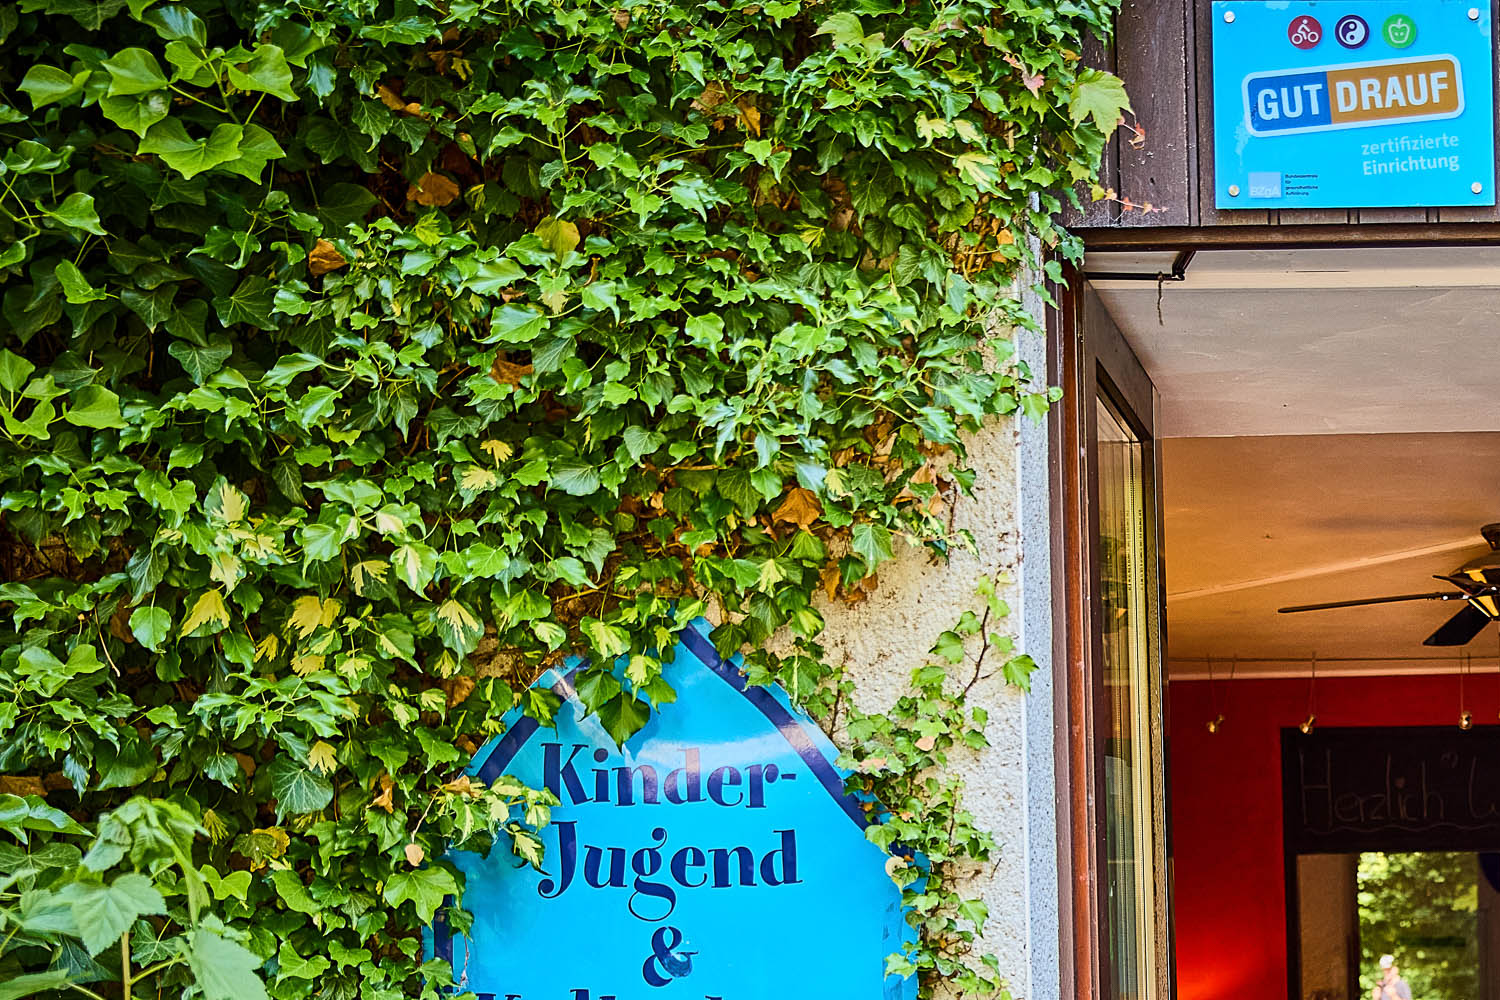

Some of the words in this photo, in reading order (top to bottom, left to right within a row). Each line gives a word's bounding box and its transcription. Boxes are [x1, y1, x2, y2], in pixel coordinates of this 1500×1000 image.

[1257, 83, 1323, 121] GUT
[1335, 71, 1449, 113] DRAUF
[1361, 133, 1460, 156] zertifizierte
[1363, 154, 1460, 176] Einrichtung
[541, 742, 797, 809] Kinder-
[1298, 747, 1444, 830] Herzlich
[538, 820, 803, 922] Jugend
[642, 926, 699, 987] &
